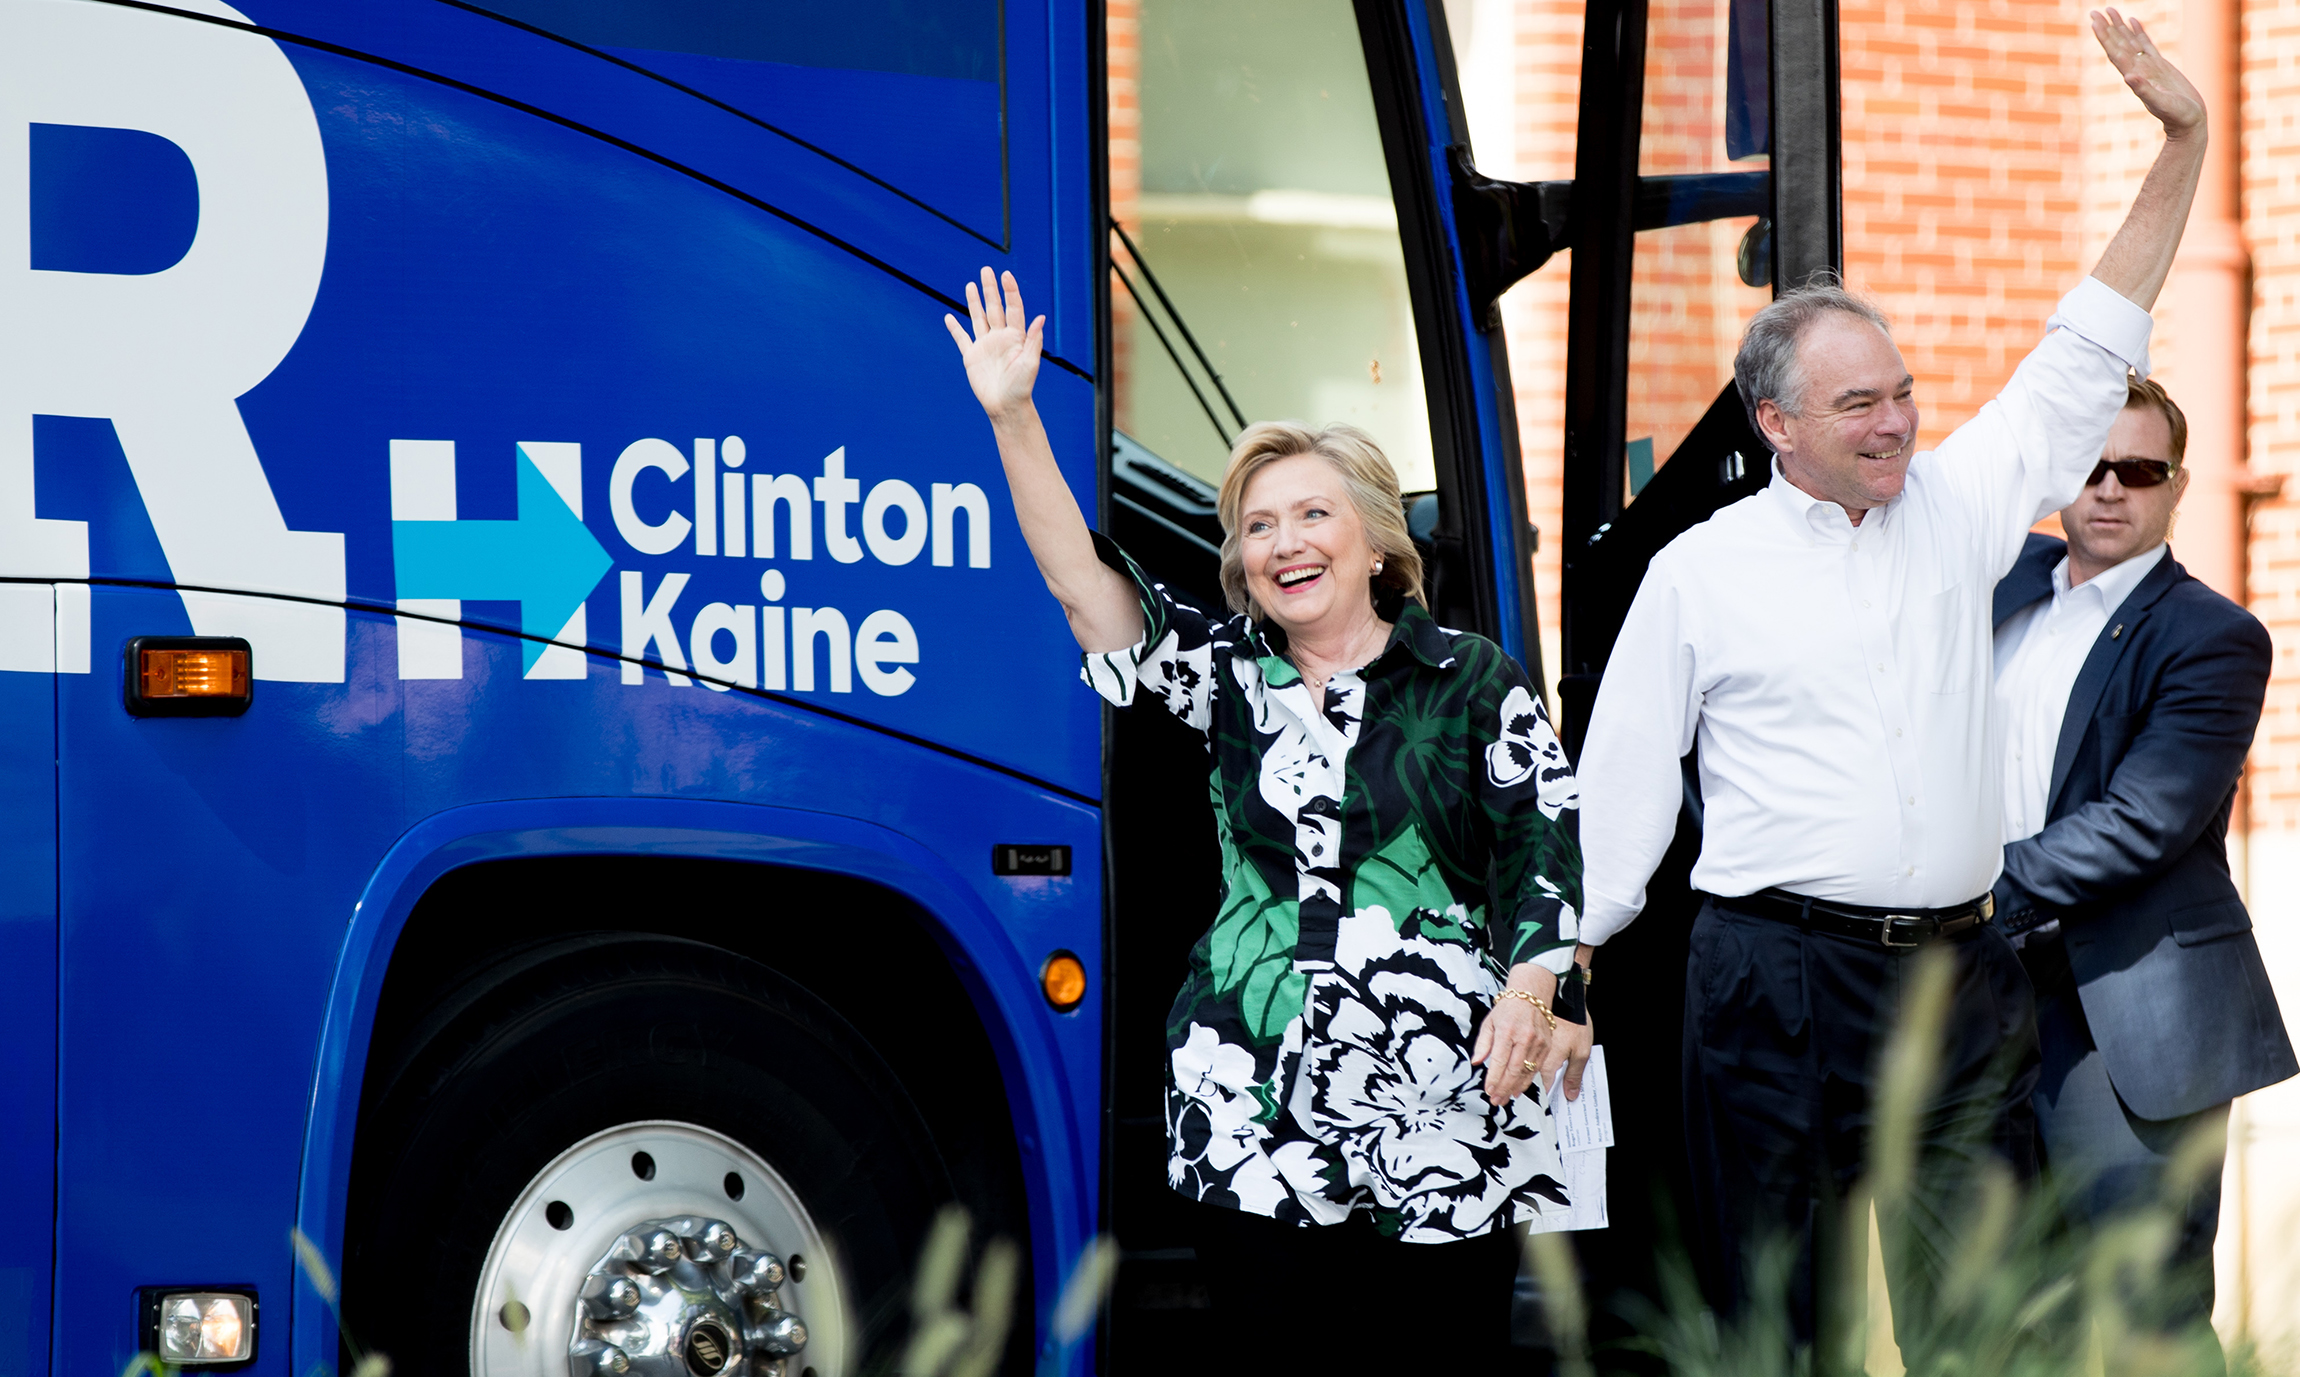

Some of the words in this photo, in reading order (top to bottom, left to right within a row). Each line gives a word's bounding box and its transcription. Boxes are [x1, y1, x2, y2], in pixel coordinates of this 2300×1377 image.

[0, 0, 345, 683] R
[610, 435, 991, 569] Clinton
[620, 569, 919, 697] Kaine
